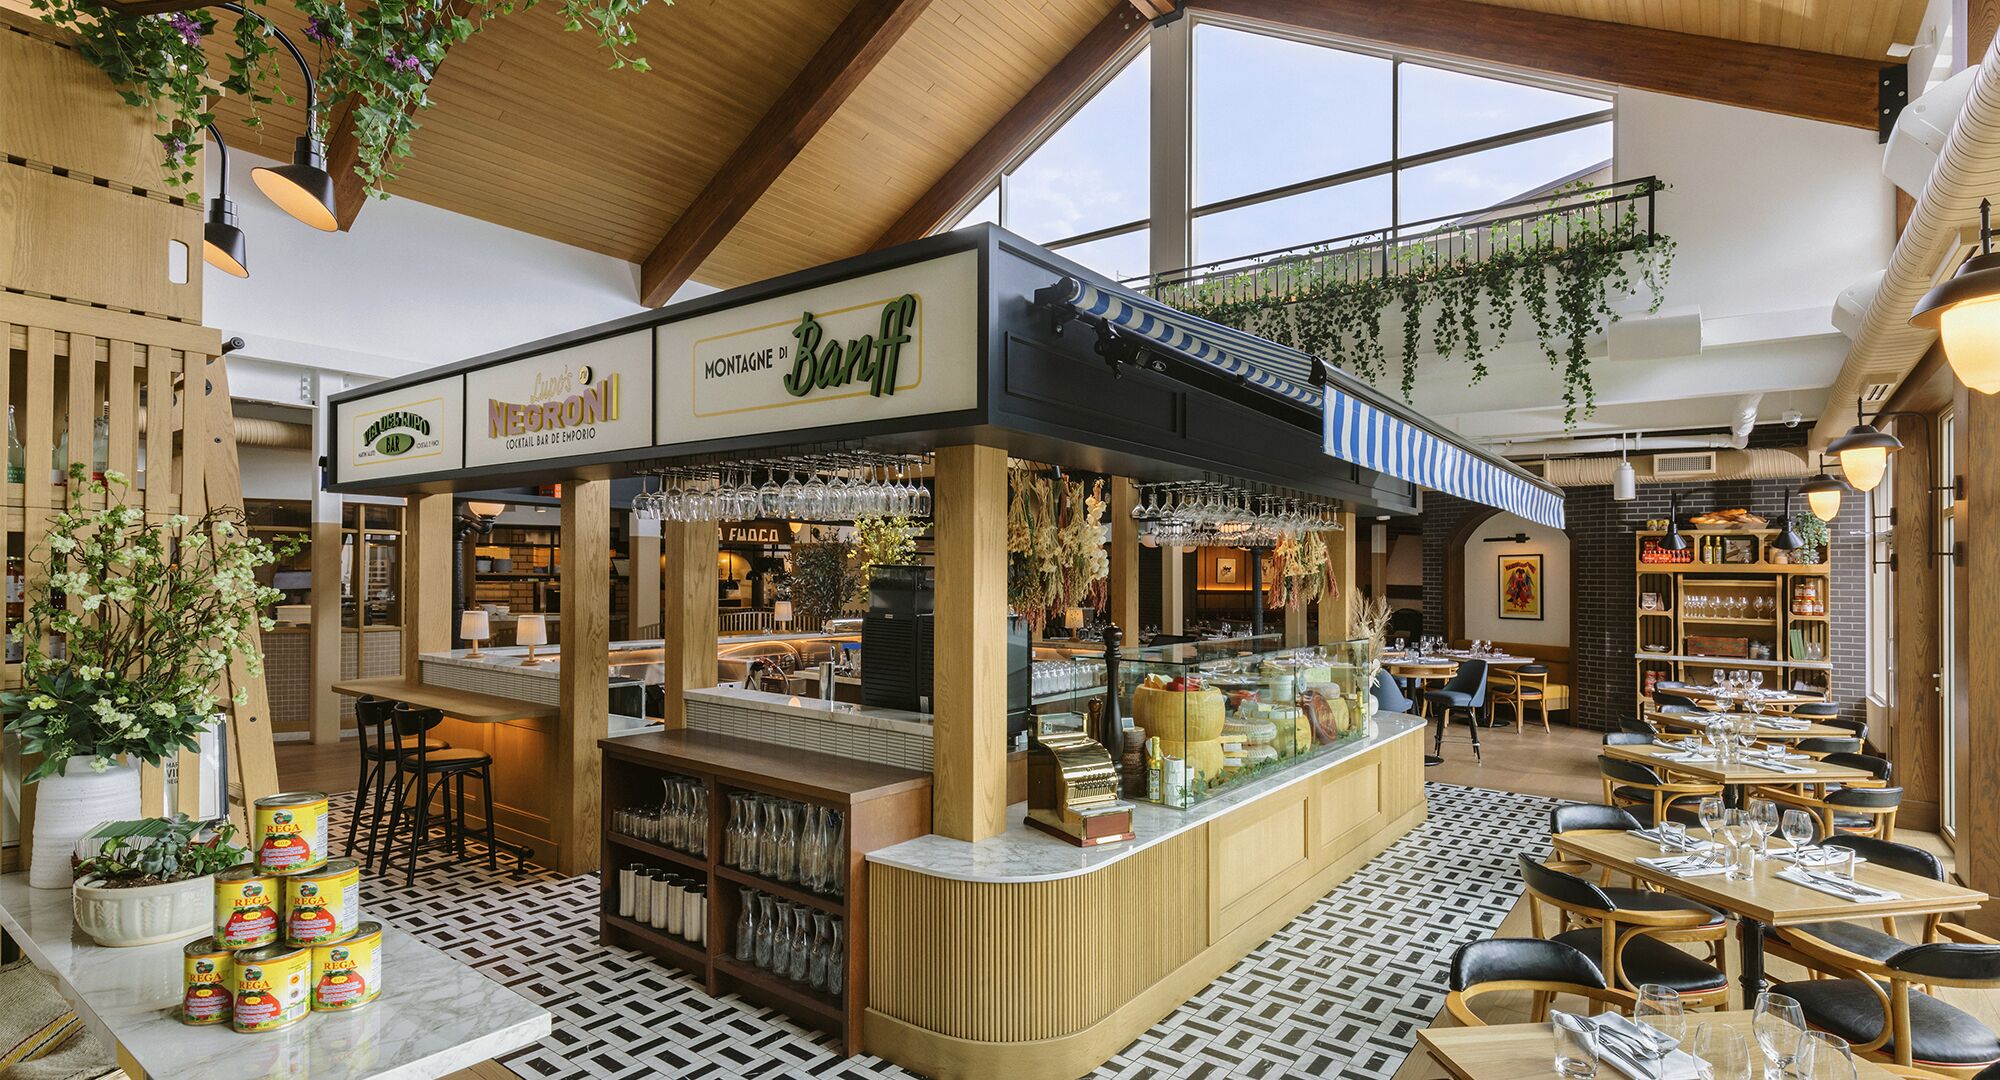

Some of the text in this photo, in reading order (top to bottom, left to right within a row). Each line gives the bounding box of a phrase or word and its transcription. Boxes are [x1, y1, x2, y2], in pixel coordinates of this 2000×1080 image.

[705, 293, 916, 397] MONTAGNE DI Banff
[488, 372, 619, 439] NEGRONI
[380, 411, 402, 432] DEL
[401, 411, 430, 436] LUPO
[386, 435, 400, 453] BAR
[505, 427, 596, 450] COCKTAIL BAR DE EMPORIO
[728, 527, 780, 542] FUOCO
[266, 823, 301, 834] REGA
[234, 894, 270, 906] REGA
[294, 895, 326, 905] REGA
[324, 959, 356, 970] REGA
[189, 972, 223, 983] REGA
[239, 980, 270, 990] REGA
